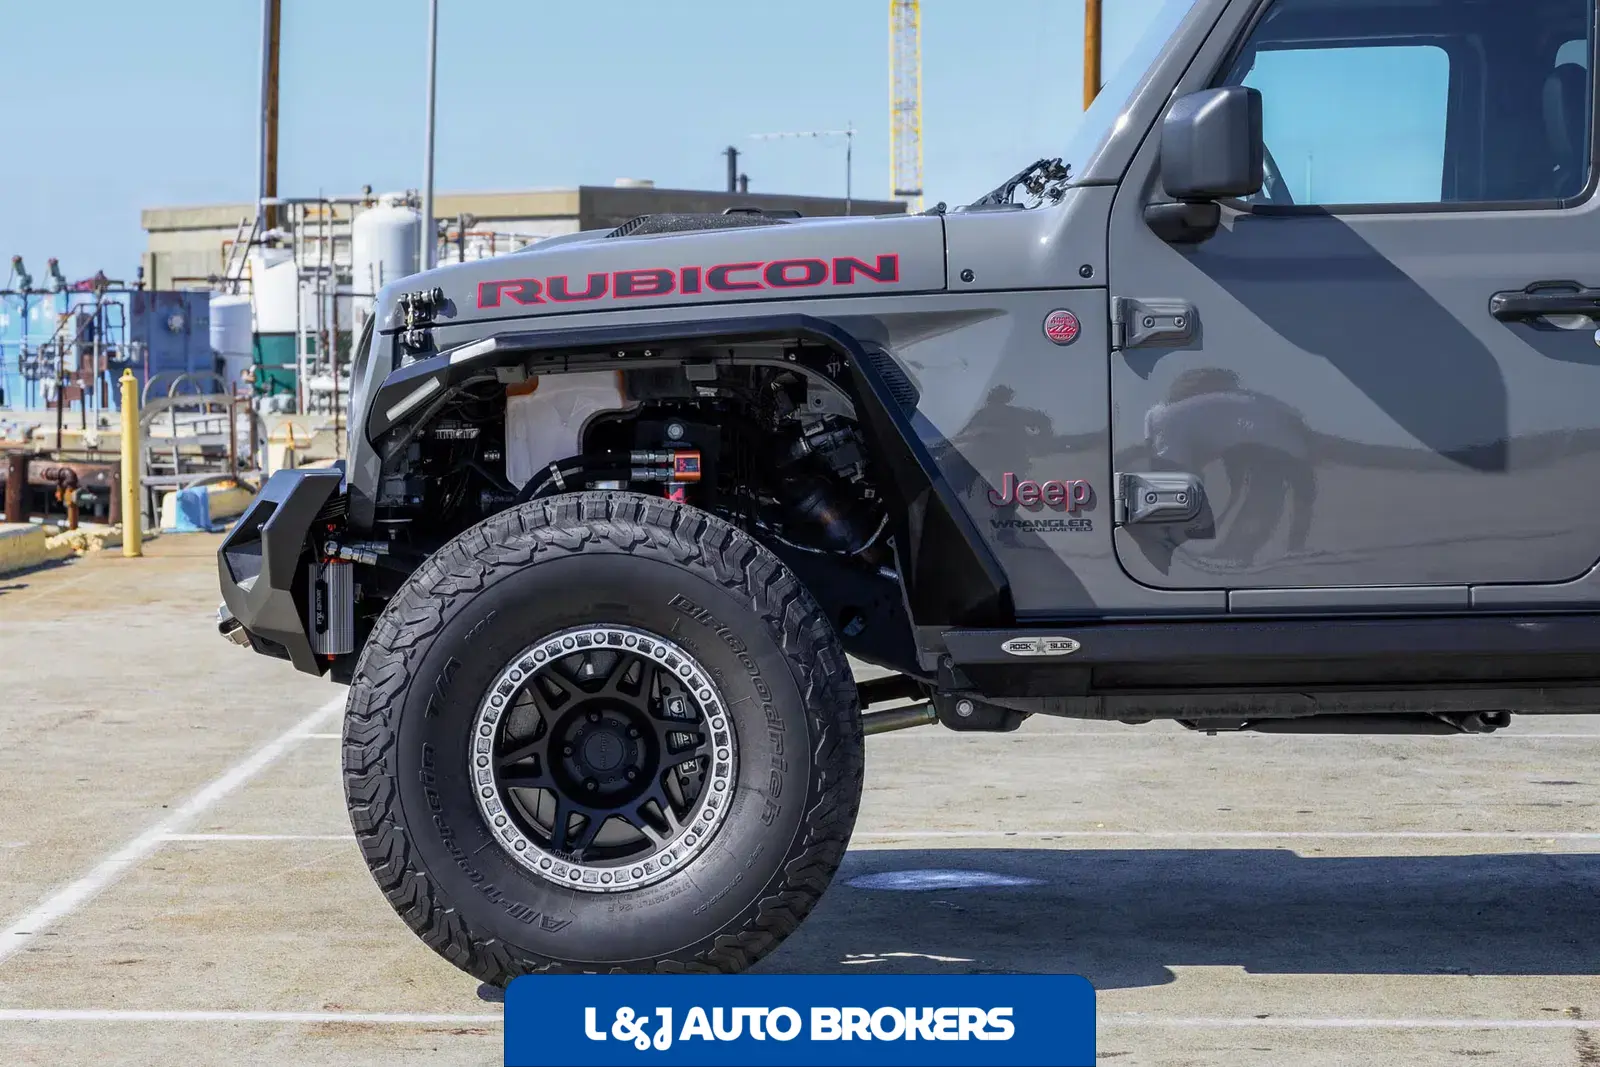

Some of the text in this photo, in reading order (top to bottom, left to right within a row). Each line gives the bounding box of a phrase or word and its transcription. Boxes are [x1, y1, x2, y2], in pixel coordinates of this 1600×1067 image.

[477, 253, 899, 308] RUBICON
[988, 472, 1092, 512] Jeep
[990, 518, 1092, 528] WRANGLER
